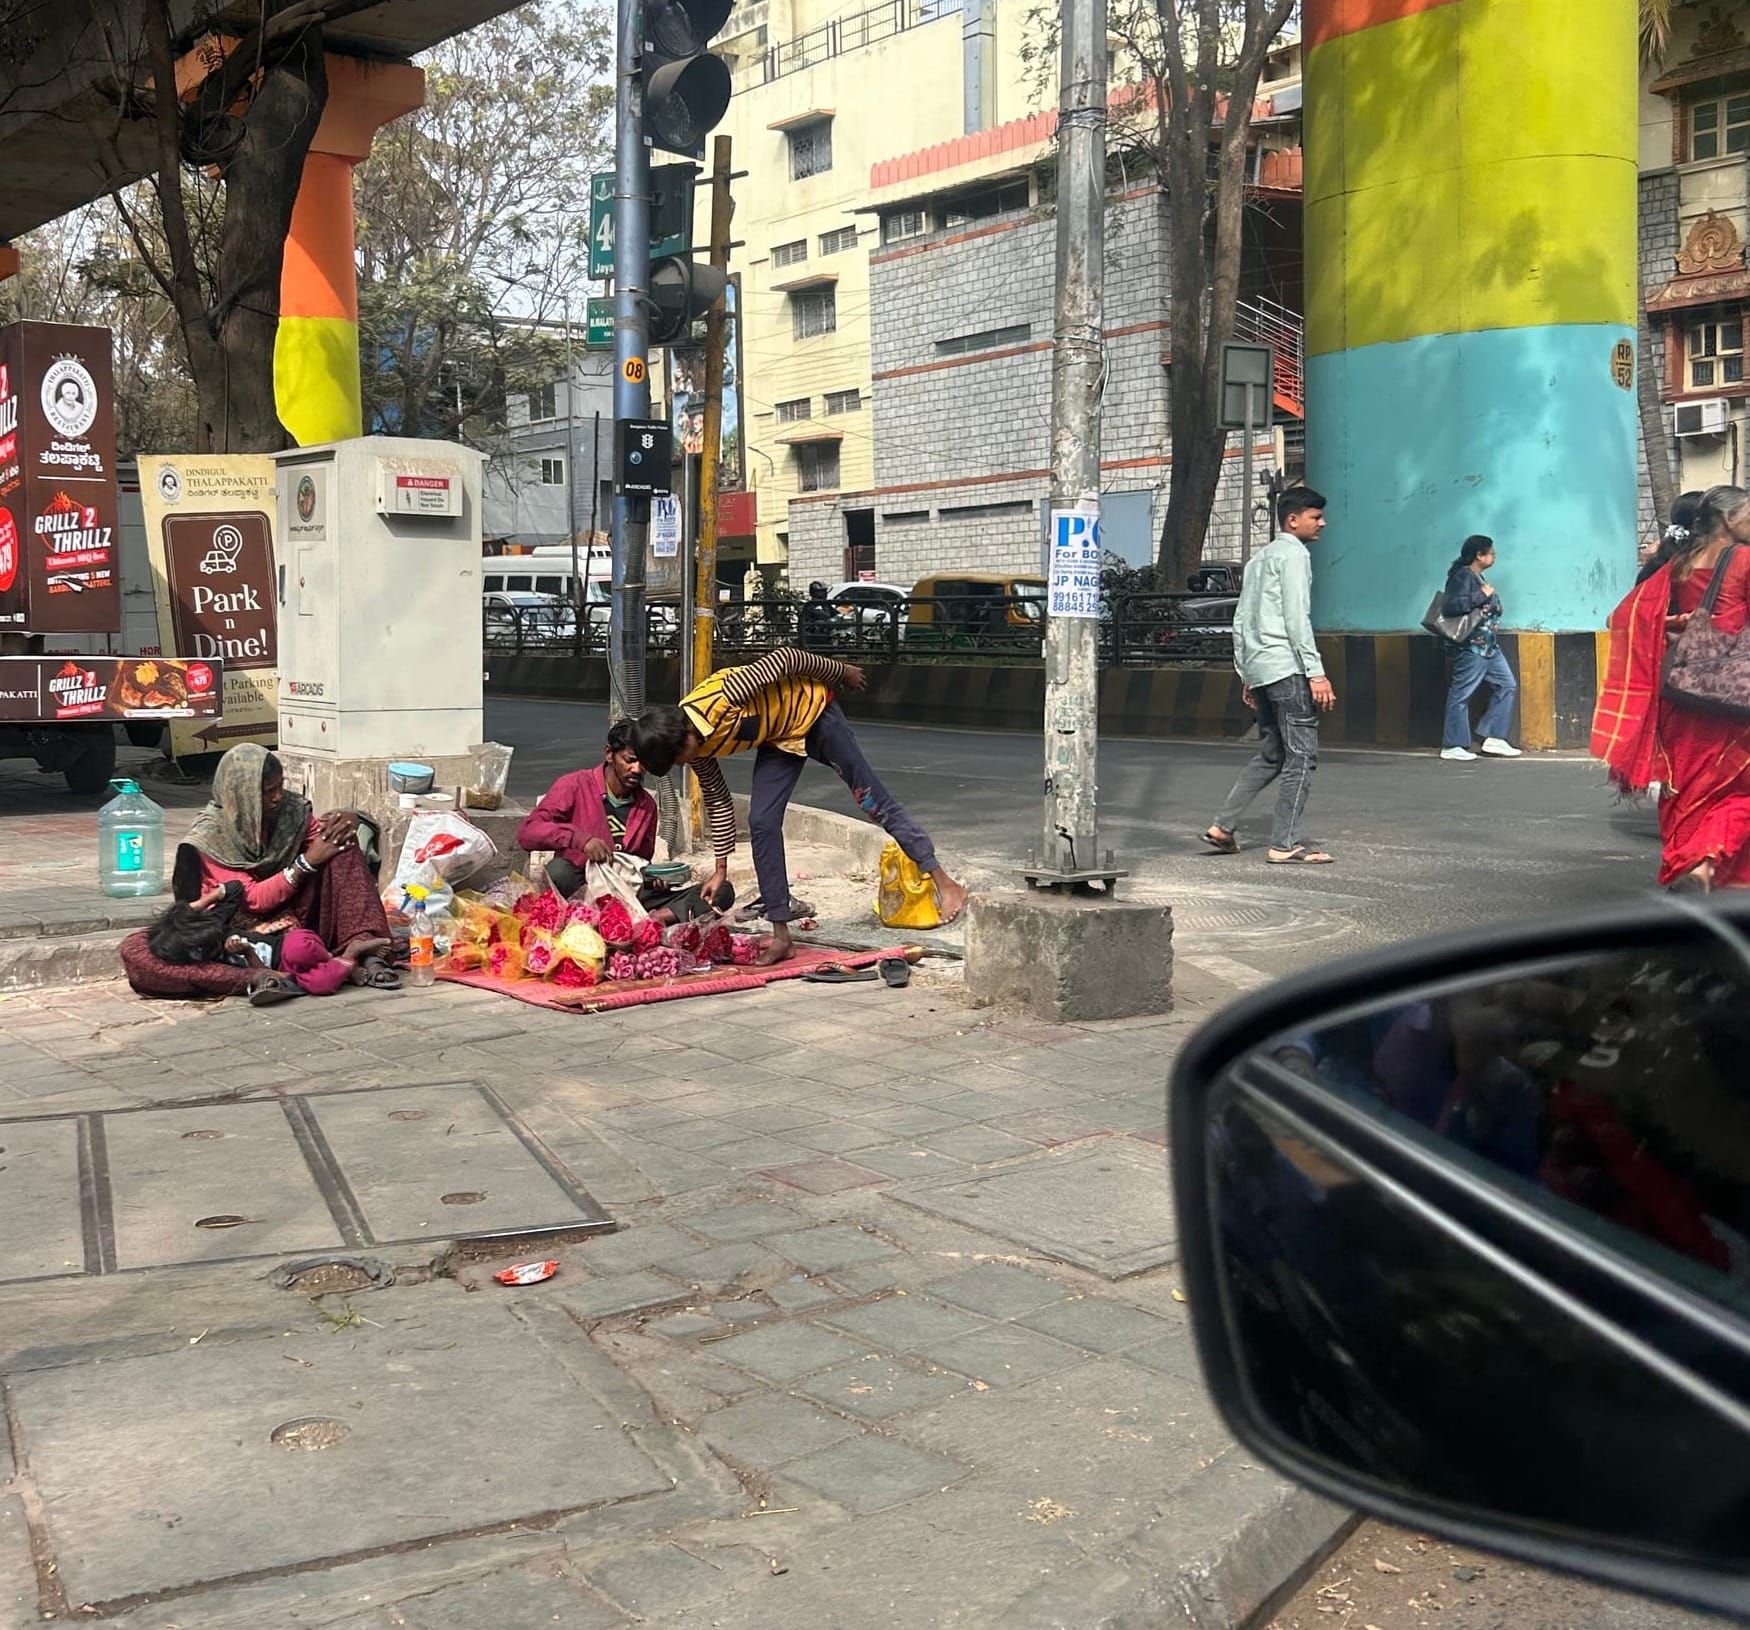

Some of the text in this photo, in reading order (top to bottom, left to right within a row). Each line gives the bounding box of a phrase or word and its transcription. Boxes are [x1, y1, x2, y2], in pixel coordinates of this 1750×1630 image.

[596, 213, 615, 252] 4
[1617, 344, 1631, 360] RP
[626, 361, 643, 379] 08
[1617, 367, 1632, 388] 52
[186, 468, 227, 476] DINDIGUL
[187, 477, 268, 487] THALAPPAKATTI
[415, 480, 444, 488] DANGER
[35, 512, 79, 534] GRILLZ
[85, 508, 96, 528] 2
[53, 527, 112, 553] THRILLZ
[1055, 550, 1077, 558] For
[1053, 576, 1069, 586] JP
[192, 584, 263, 613] Park
[224, 618, 235, 629] n
[192, 628, 268, 658] Dine!
[49, 671, 96, 692] GRILLZ 2
[231, 677, 274, 690] Parking
[296, 682, 325, 696] ARCADIS
[62, 686, 107, 706] THRILLZ
